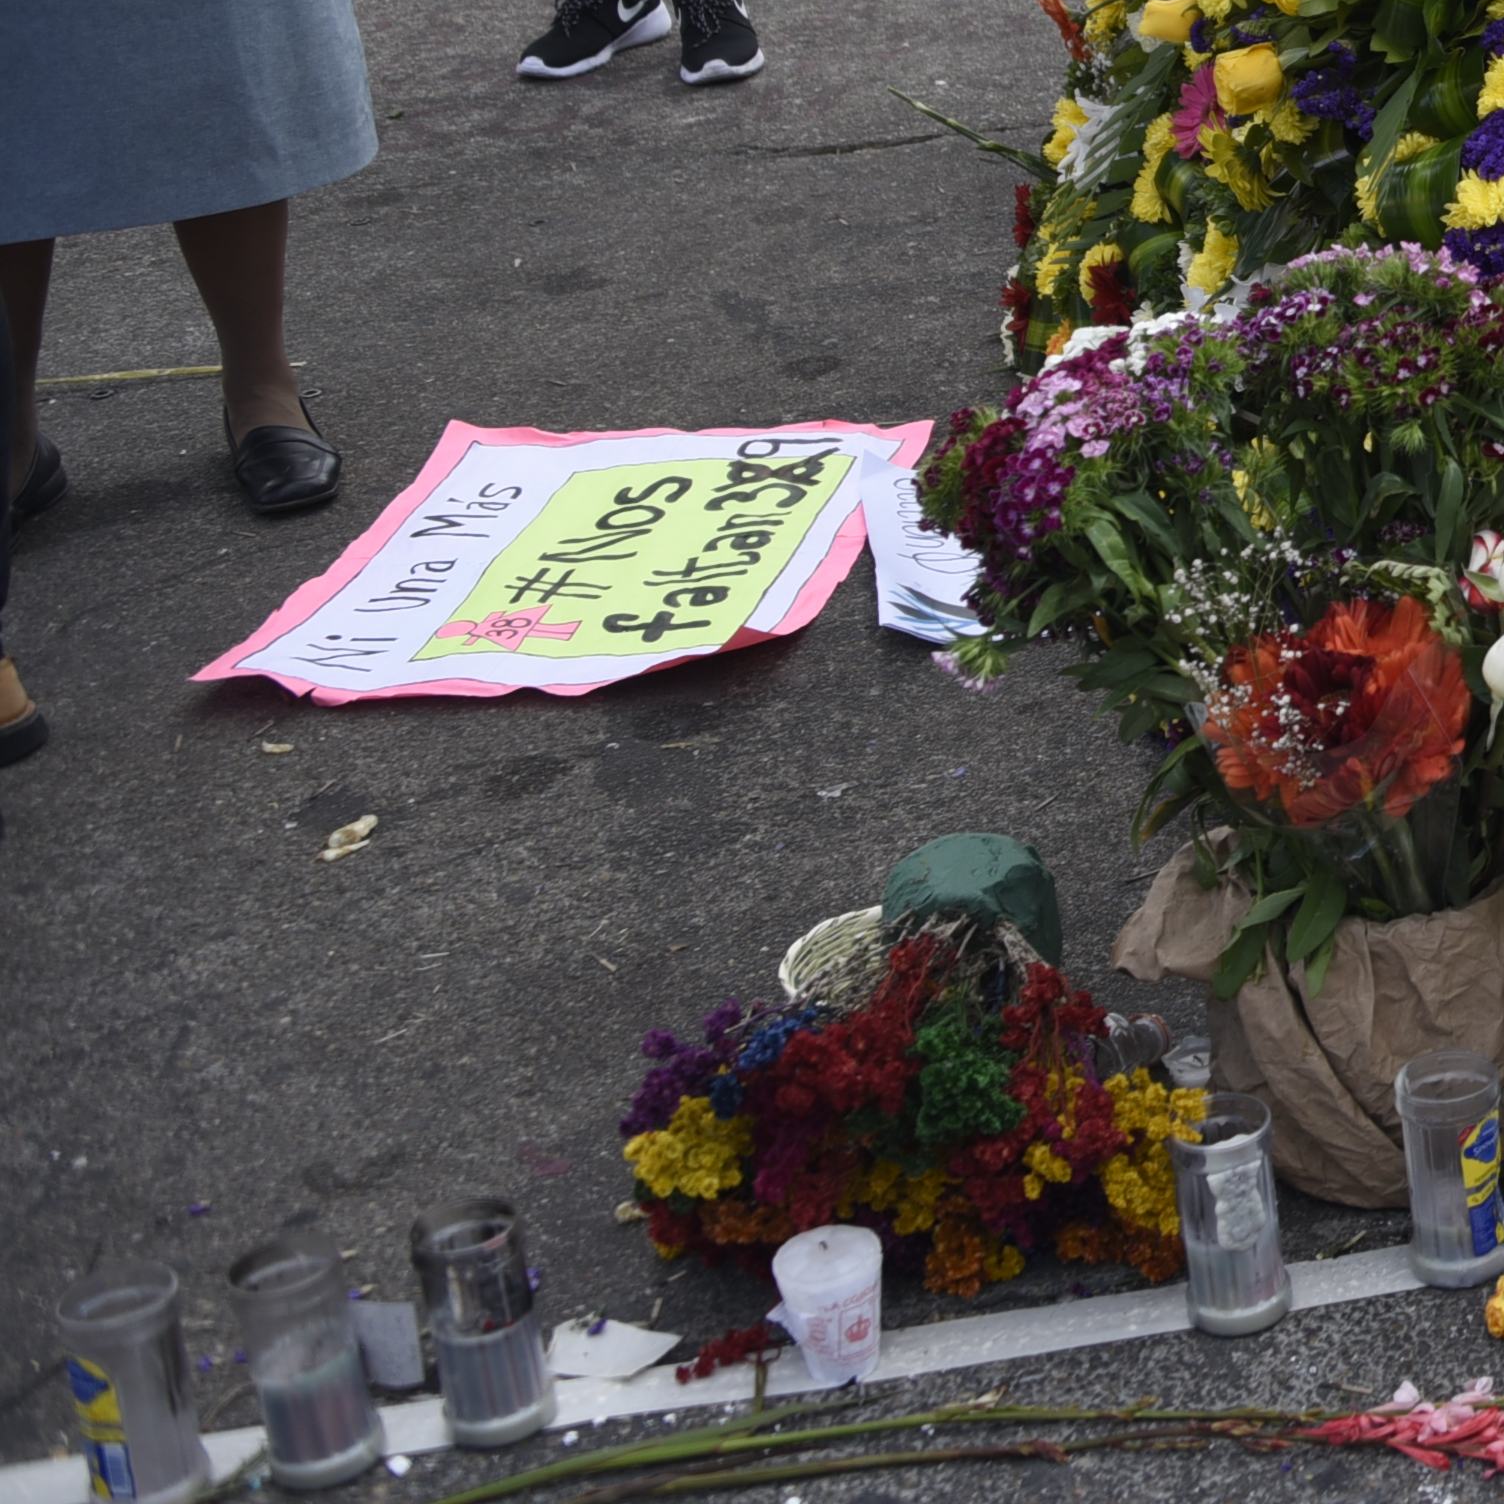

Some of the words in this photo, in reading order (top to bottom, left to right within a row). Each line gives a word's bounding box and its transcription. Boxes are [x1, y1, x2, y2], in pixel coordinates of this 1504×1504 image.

[292, 633, 399, 673] Ni
[353, 557, 459, 613] Una
[409, 482, 523, 539] Más
[485, 616, 533, 640] 38
